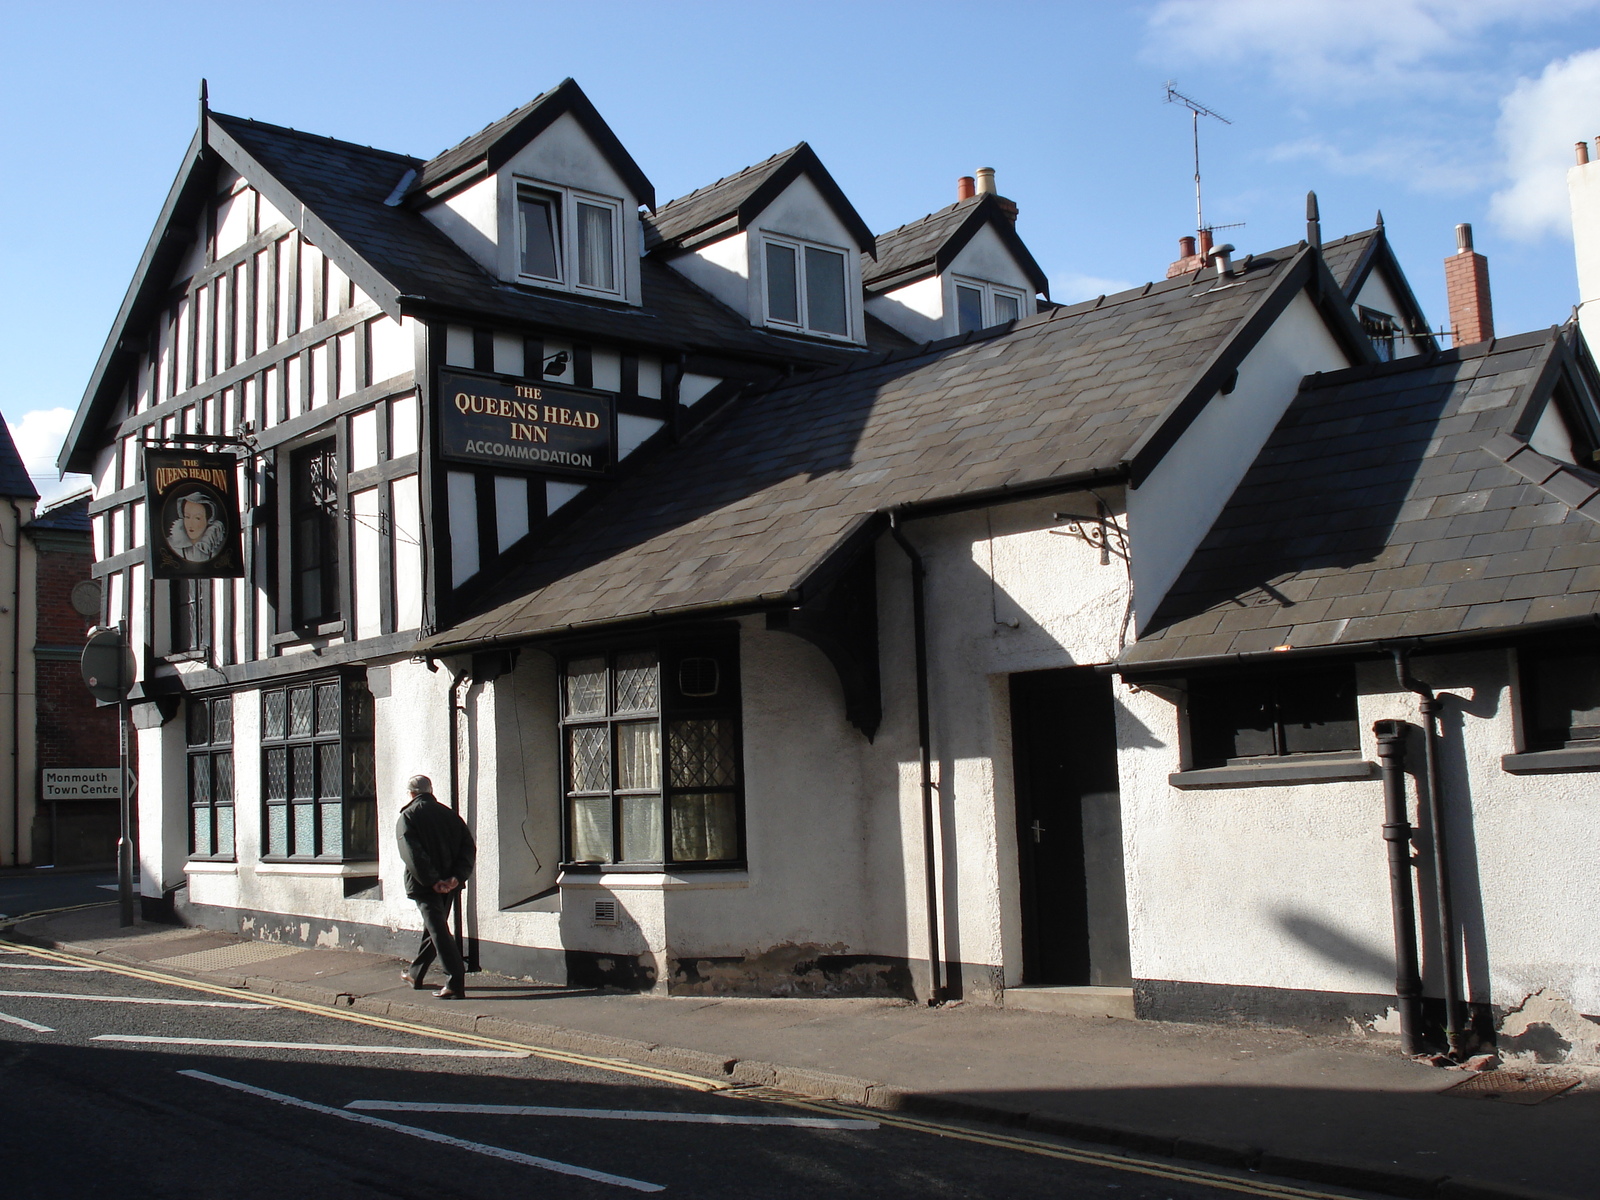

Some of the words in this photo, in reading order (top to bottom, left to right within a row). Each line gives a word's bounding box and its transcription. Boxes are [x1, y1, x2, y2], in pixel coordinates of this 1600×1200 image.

[514, 386, 542, 400] THE
[454, 393, 539, 421] QUEENS
[543, 405, 600, 429] HEAD
[510, 422, 548, 443] INN
[465, 440, 592, 467] ACCOMMODATION
[181, 459, 199, 467] THE
[156, 467, 188, 495] QUEENS
[189, 468, 212, 482] HEAD
[212, 469, 228, 494] INN
[46, 773, 108, 782] Monmouth
[47, 785, 78, 794] Town
[81, 785, 118, 794] Centre
